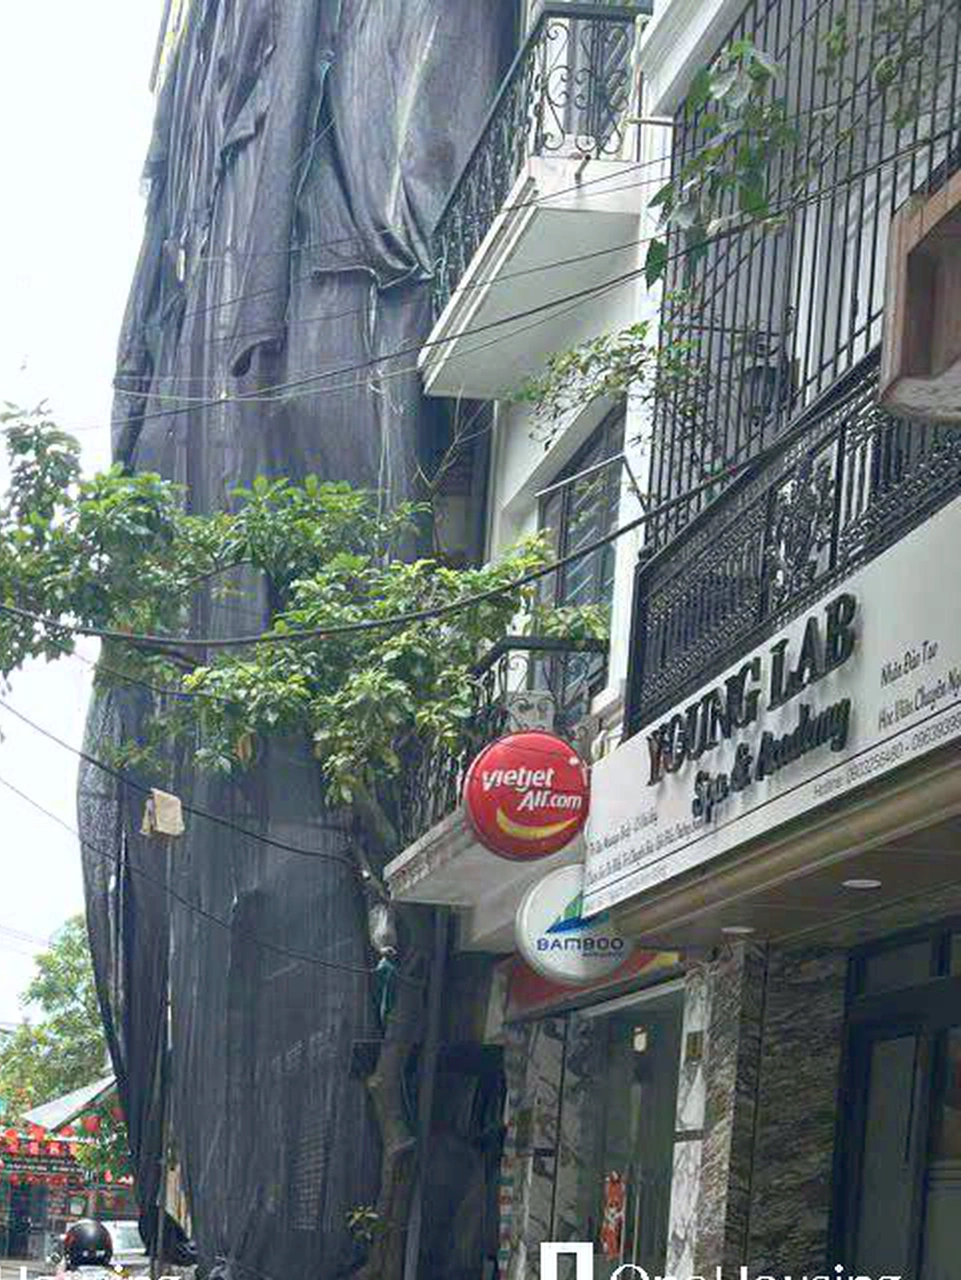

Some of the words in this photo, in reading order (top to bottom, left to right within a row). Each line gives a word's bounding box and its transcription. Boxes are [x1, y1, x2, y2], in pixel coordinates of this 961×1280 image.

[647, 657, 760, 786] YOUNG
[768, 593, 857, 711] LAB
[692, 770, 728, 822] Spa
[731, 743, 753, 792] &
[537, 937, 624, 951] BAMBOO
